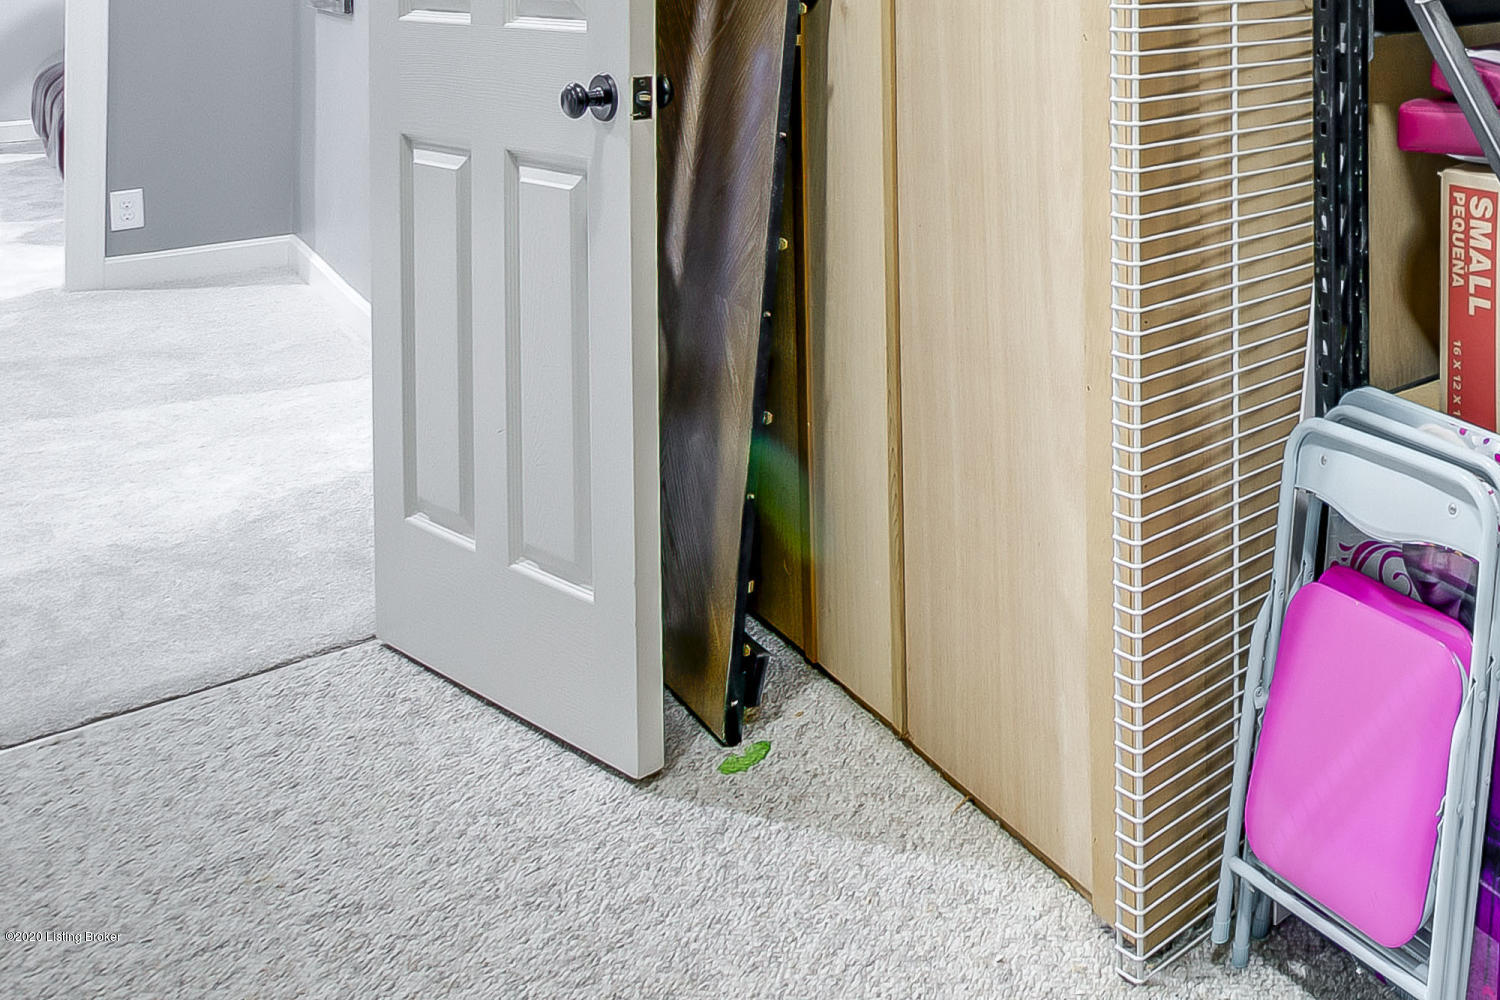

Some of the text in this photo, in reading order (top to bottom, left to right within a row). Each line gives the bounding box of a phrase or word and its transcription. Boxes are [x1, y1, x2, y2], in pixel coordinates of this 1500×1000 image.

[1468, 195, 1494, 317] SMALL
[1453, 340, 1462, 356] 16
[1453, 359, 1462, 370] X
[1453, 374, 1462, 390] 12
